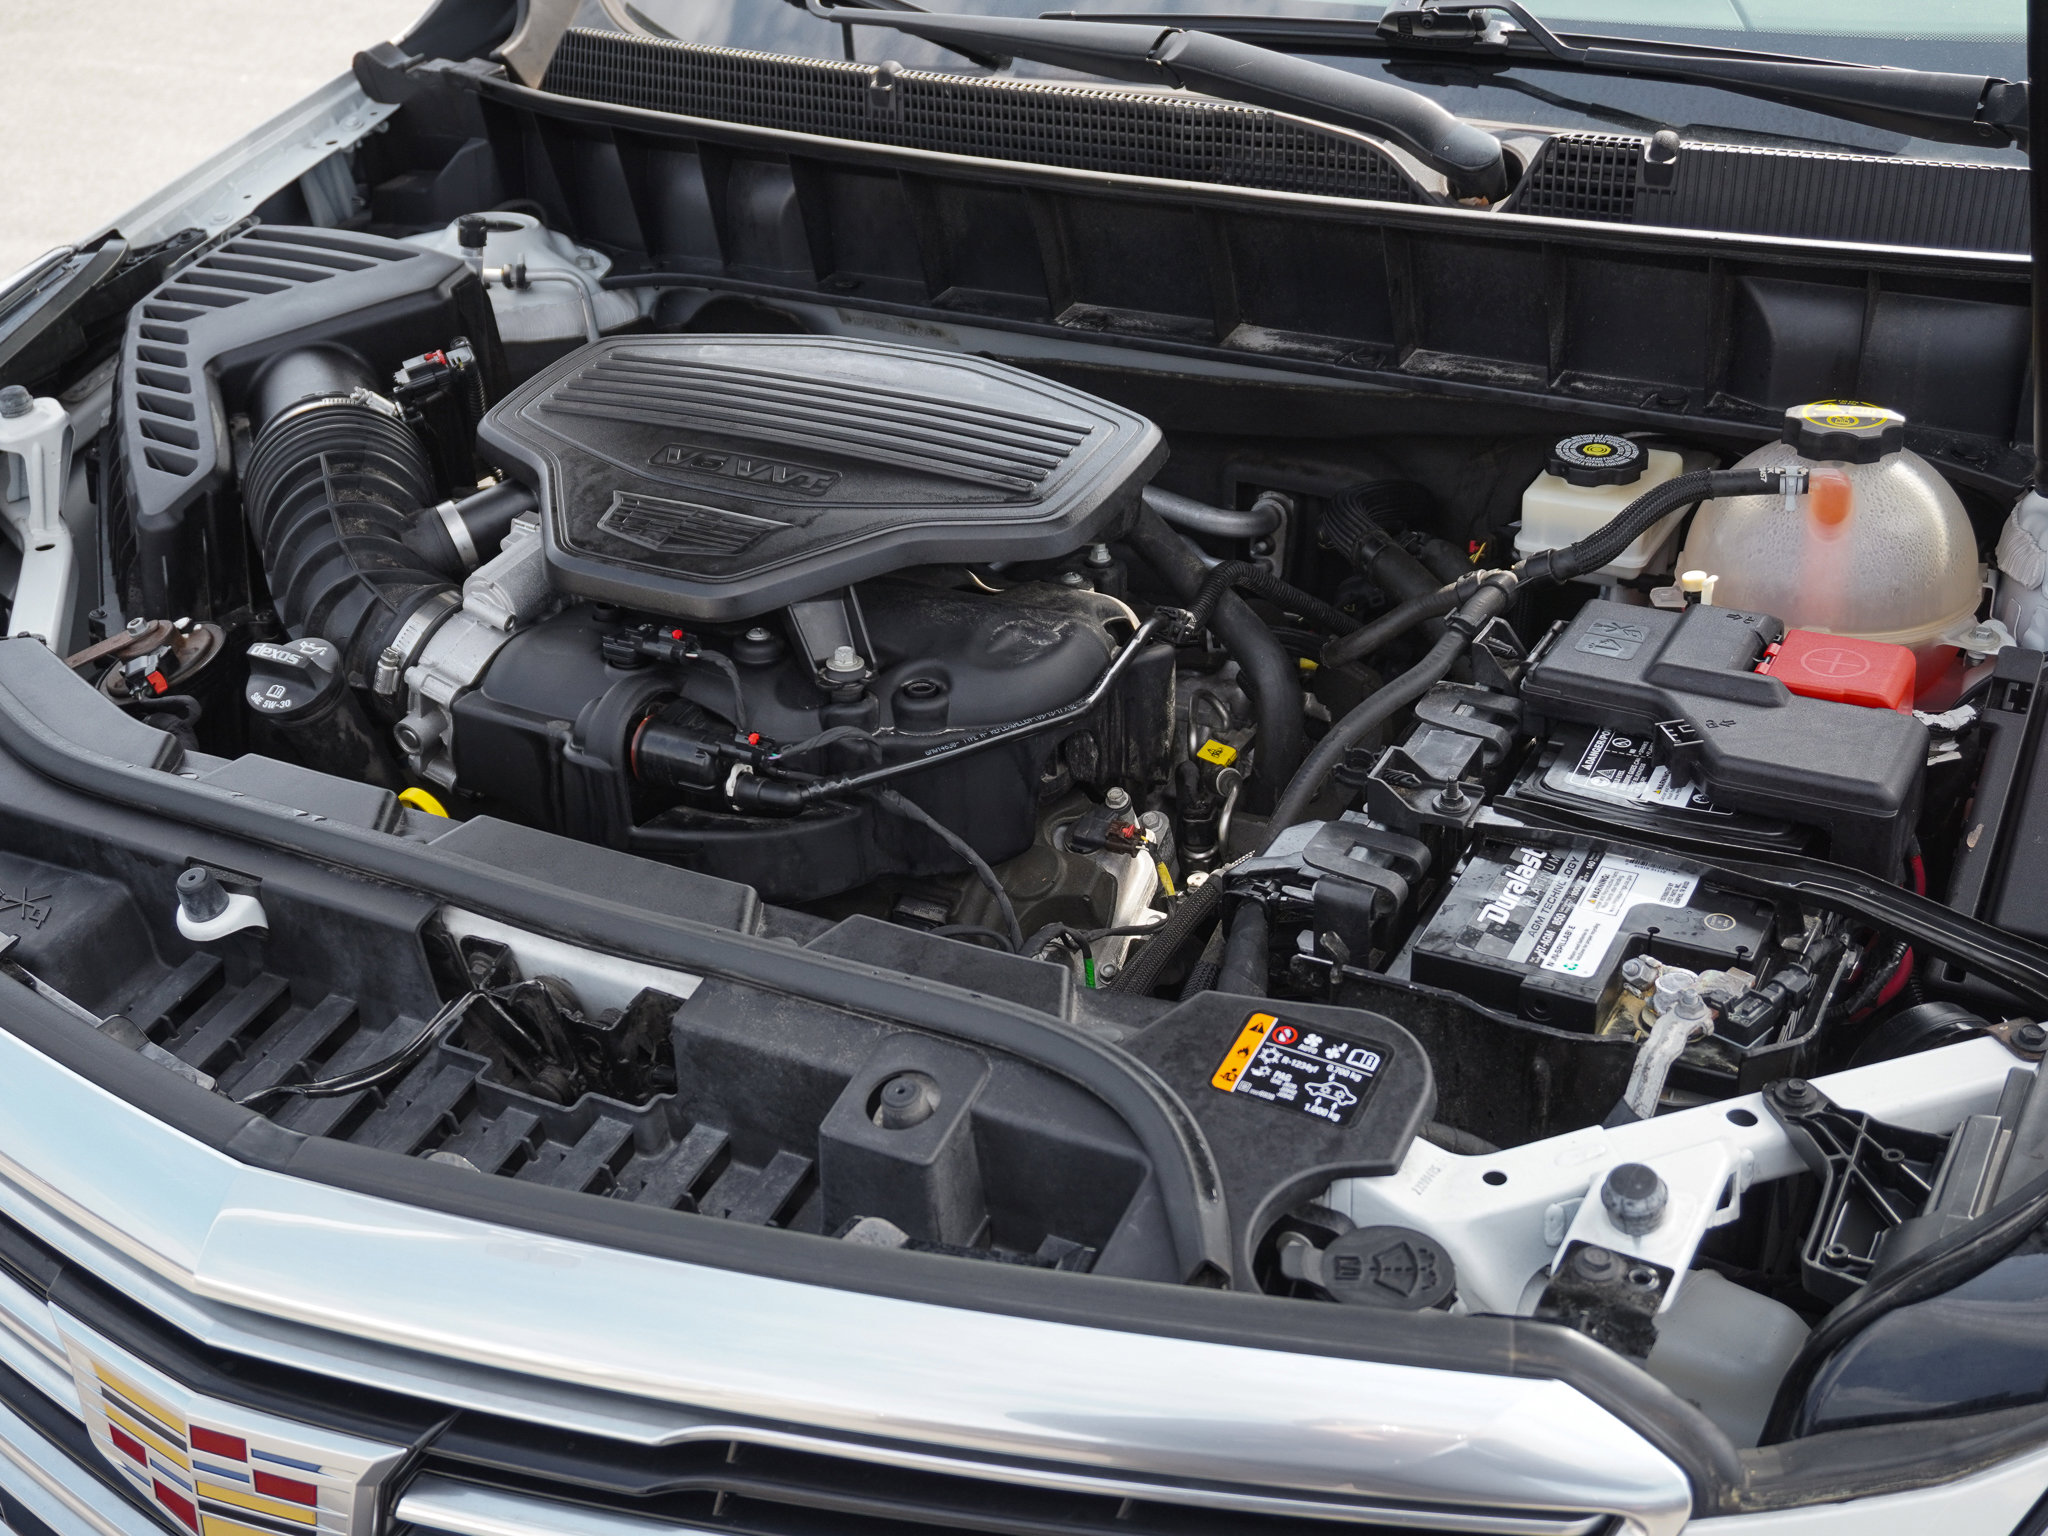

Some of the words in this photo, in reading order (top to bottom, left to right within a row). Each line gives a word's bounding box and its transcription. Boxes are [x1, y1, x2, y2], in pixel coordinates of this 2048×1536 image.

[250, 643, 301, 665] dexos
[250, 692, 265, 705] SAE
[262, 699, 292, 709] 5W-30
[1476, 847, 1549, 925] Duralast
[1527, 915, 1546, 938] AGM
[1541, 856, 1581, 916] TECHNOGY
[1551, 912, 1567, 926] 850
